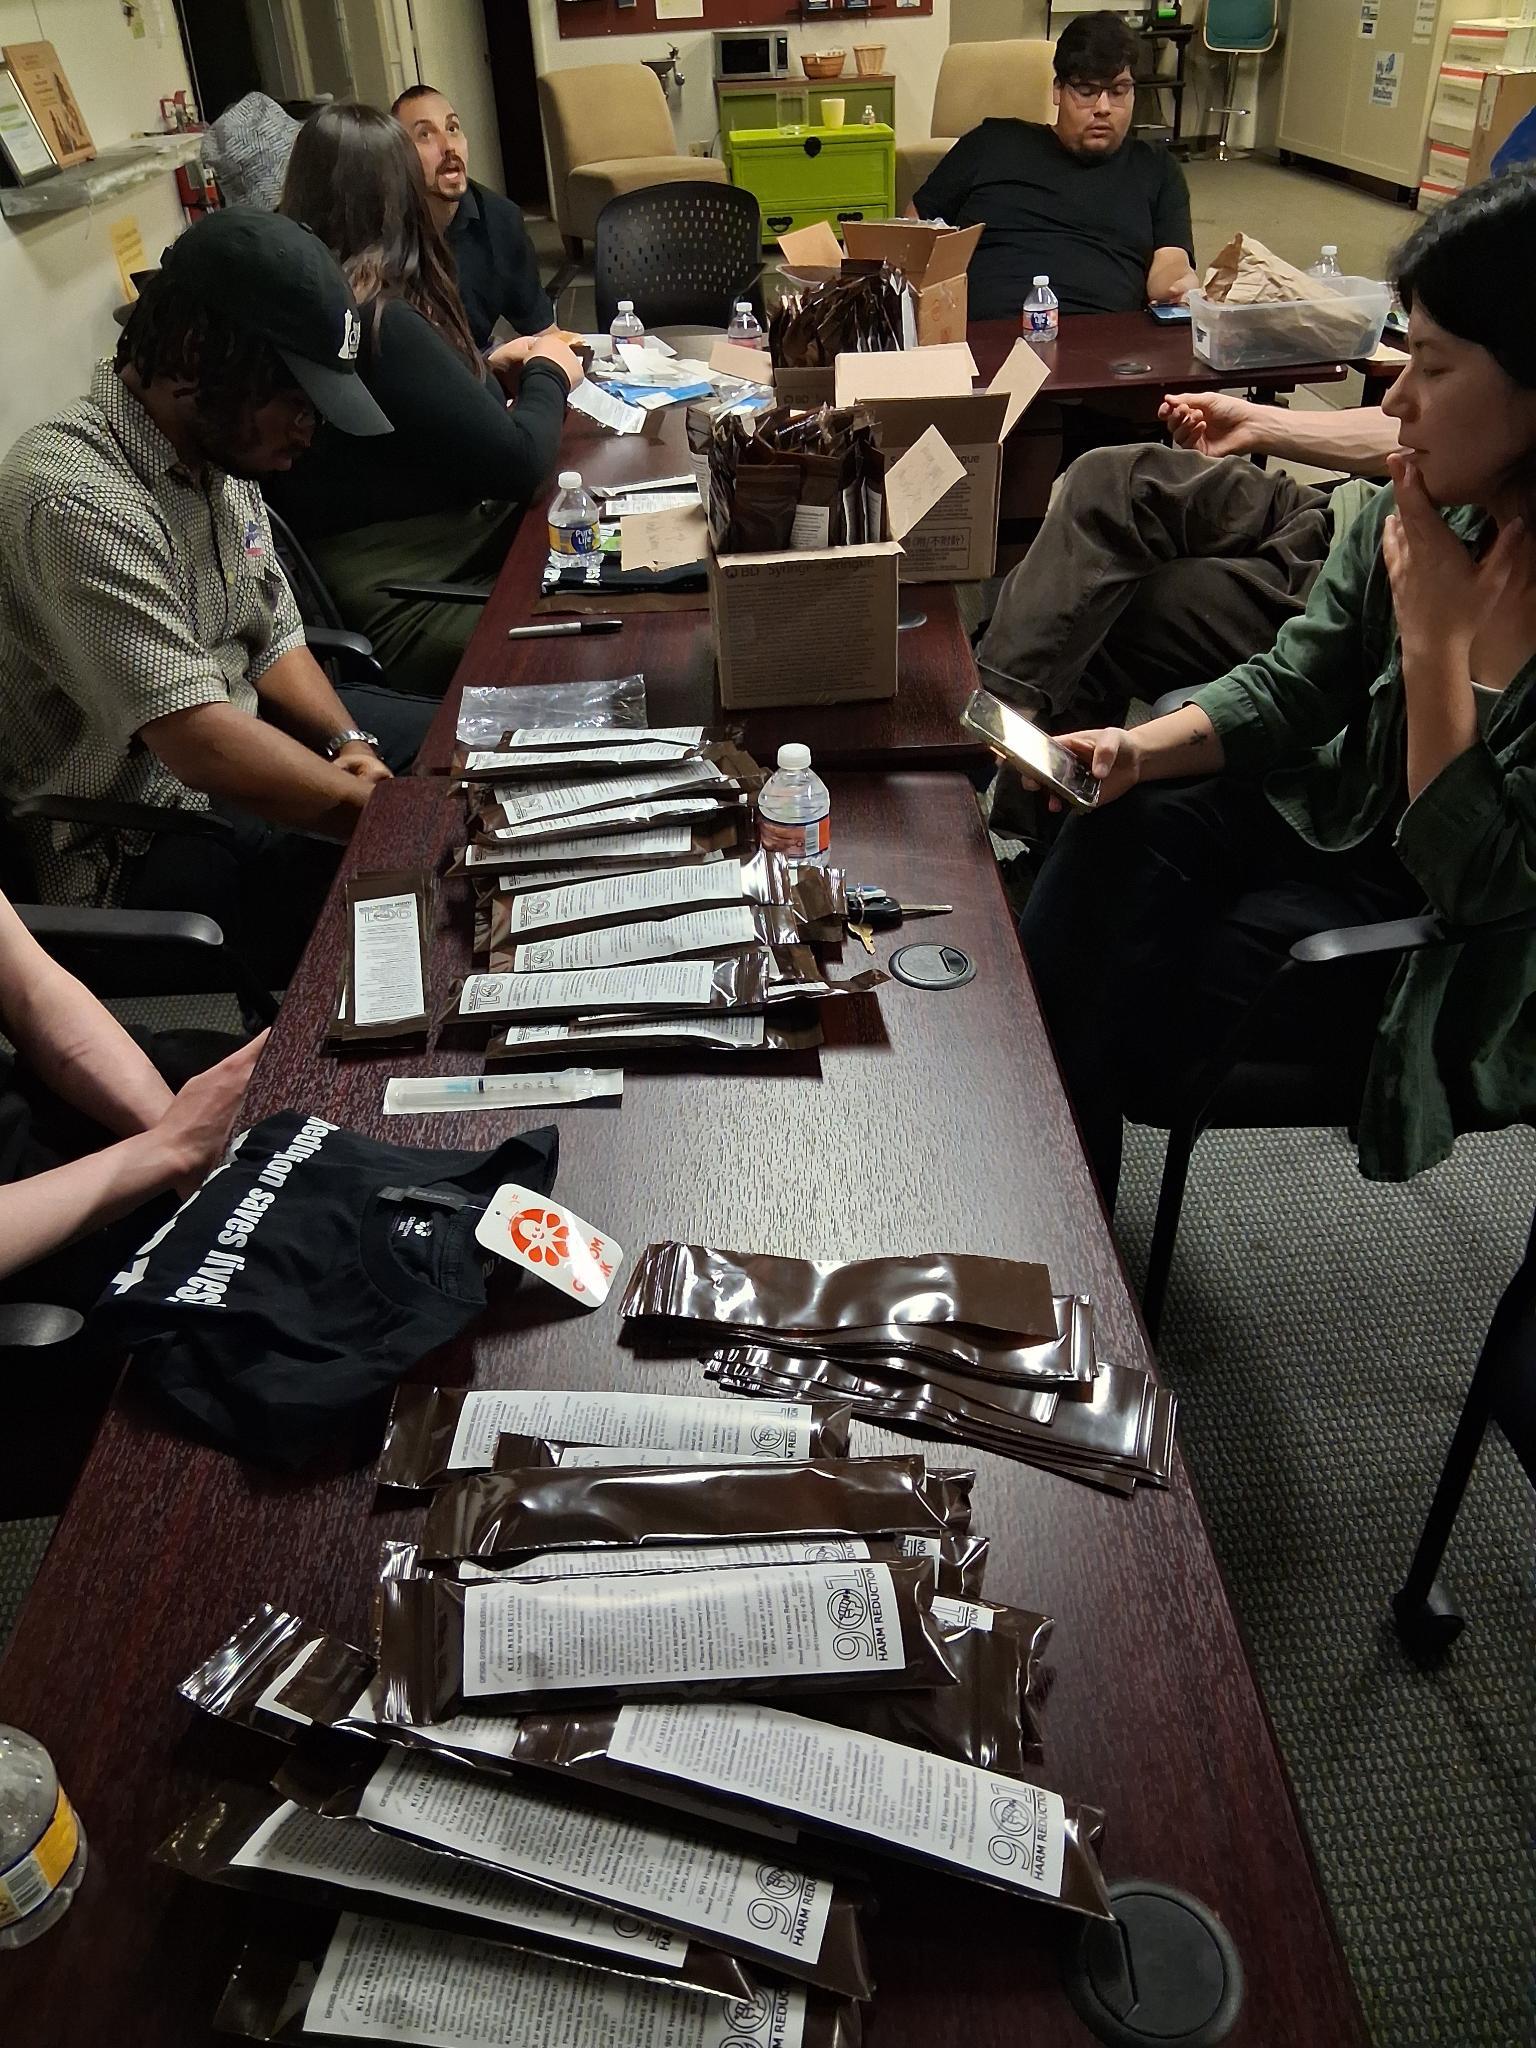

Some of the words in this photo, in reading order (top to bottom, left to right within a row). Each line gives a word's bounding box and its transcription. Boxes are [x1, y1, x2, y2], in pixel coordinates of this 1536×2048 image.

[575, 528, 593, 539] Pure
[578, 536, 592, 548] Life
[217, 1188, 275, 1247] saves
[778, 1580, 790, 1613] Reductio
[861, 1566, 884, 1623] REDUCTION
[820, 1569, 877, 1661] 901
[872, 1626, 889, 1661] HARM
[409, 1792, 421, 1808] KIT
[984, 1776, 1035, 1874] 901
[1033, 1843, 1046, 1881] HARM
[742, 1860, 804, 1938] 90
[791, 1906, 811, 1946] HARM
[354, 1994, 366, 2011] KIT
[771, 1986, 794, 2033] REDUC
[663, 2029, 676, 2047] 901
